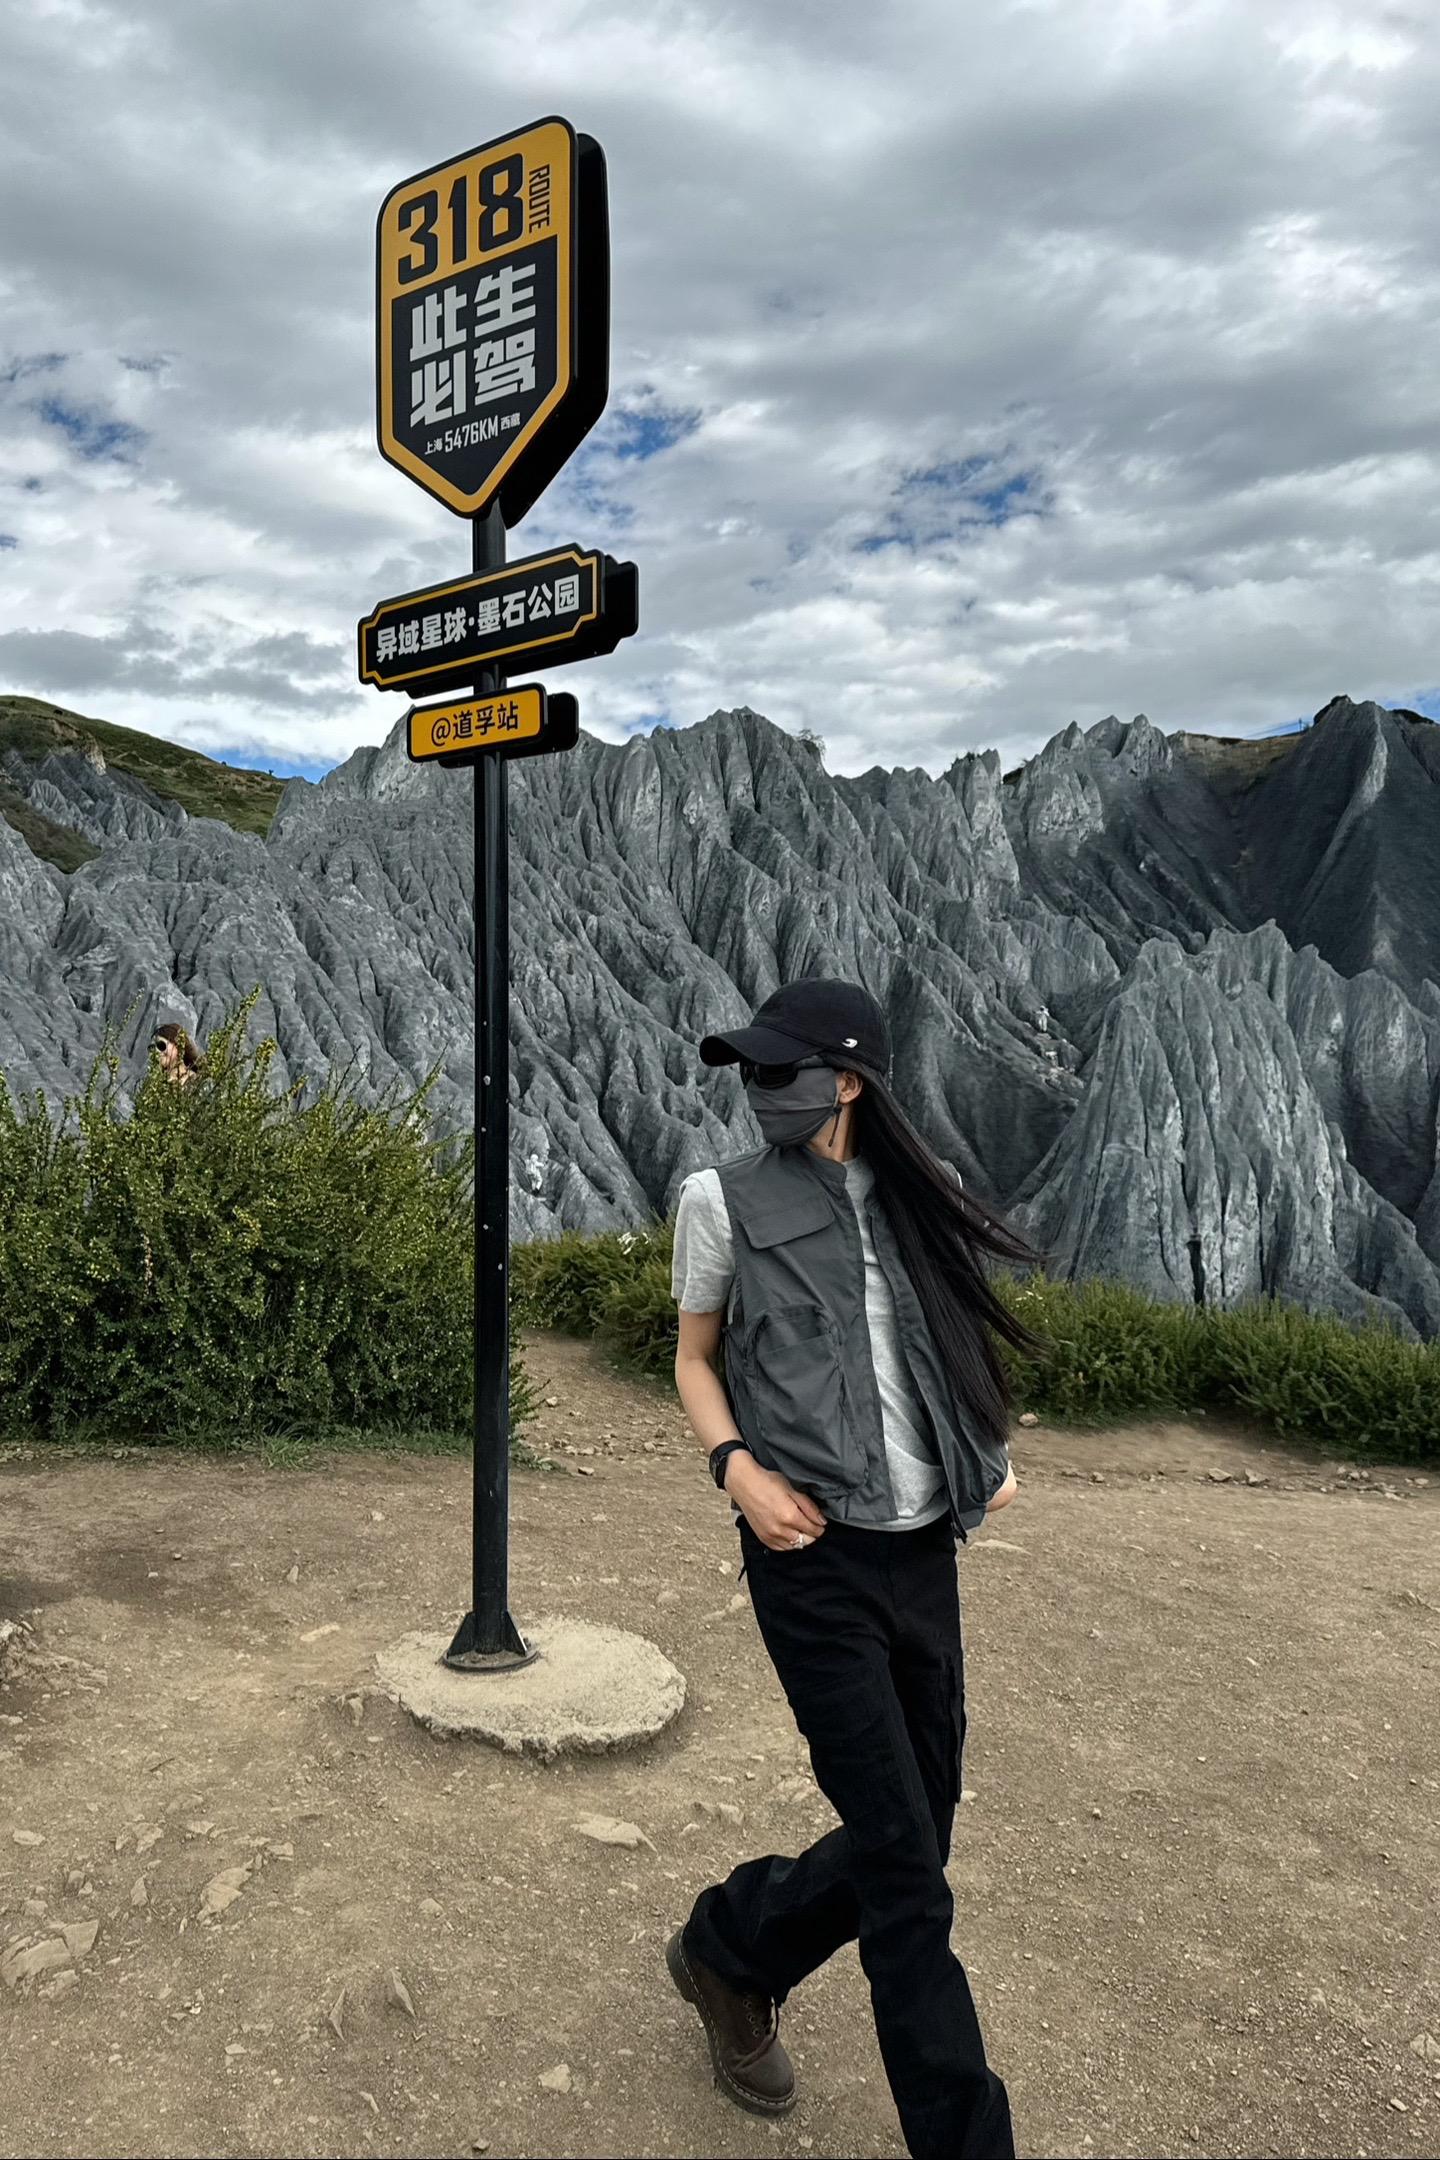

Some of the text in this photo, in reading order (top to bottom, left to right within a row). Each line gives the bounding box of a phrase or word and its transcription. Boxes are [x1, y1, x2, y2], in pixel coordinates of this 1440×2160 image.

[398, 152, 523, 285] 318
[528, 164, 550, 234] ROUTE
[409, 263, 536, 362] 此生
[410, 328, 536, 428] 必驾
[424, 438, 442, 455] 上海
[445, 415, 498, 453] 5476KM
[376, 574, 580, 664] 异域星球·墨石公园
[431, 701, 519, 746] @道孚站
